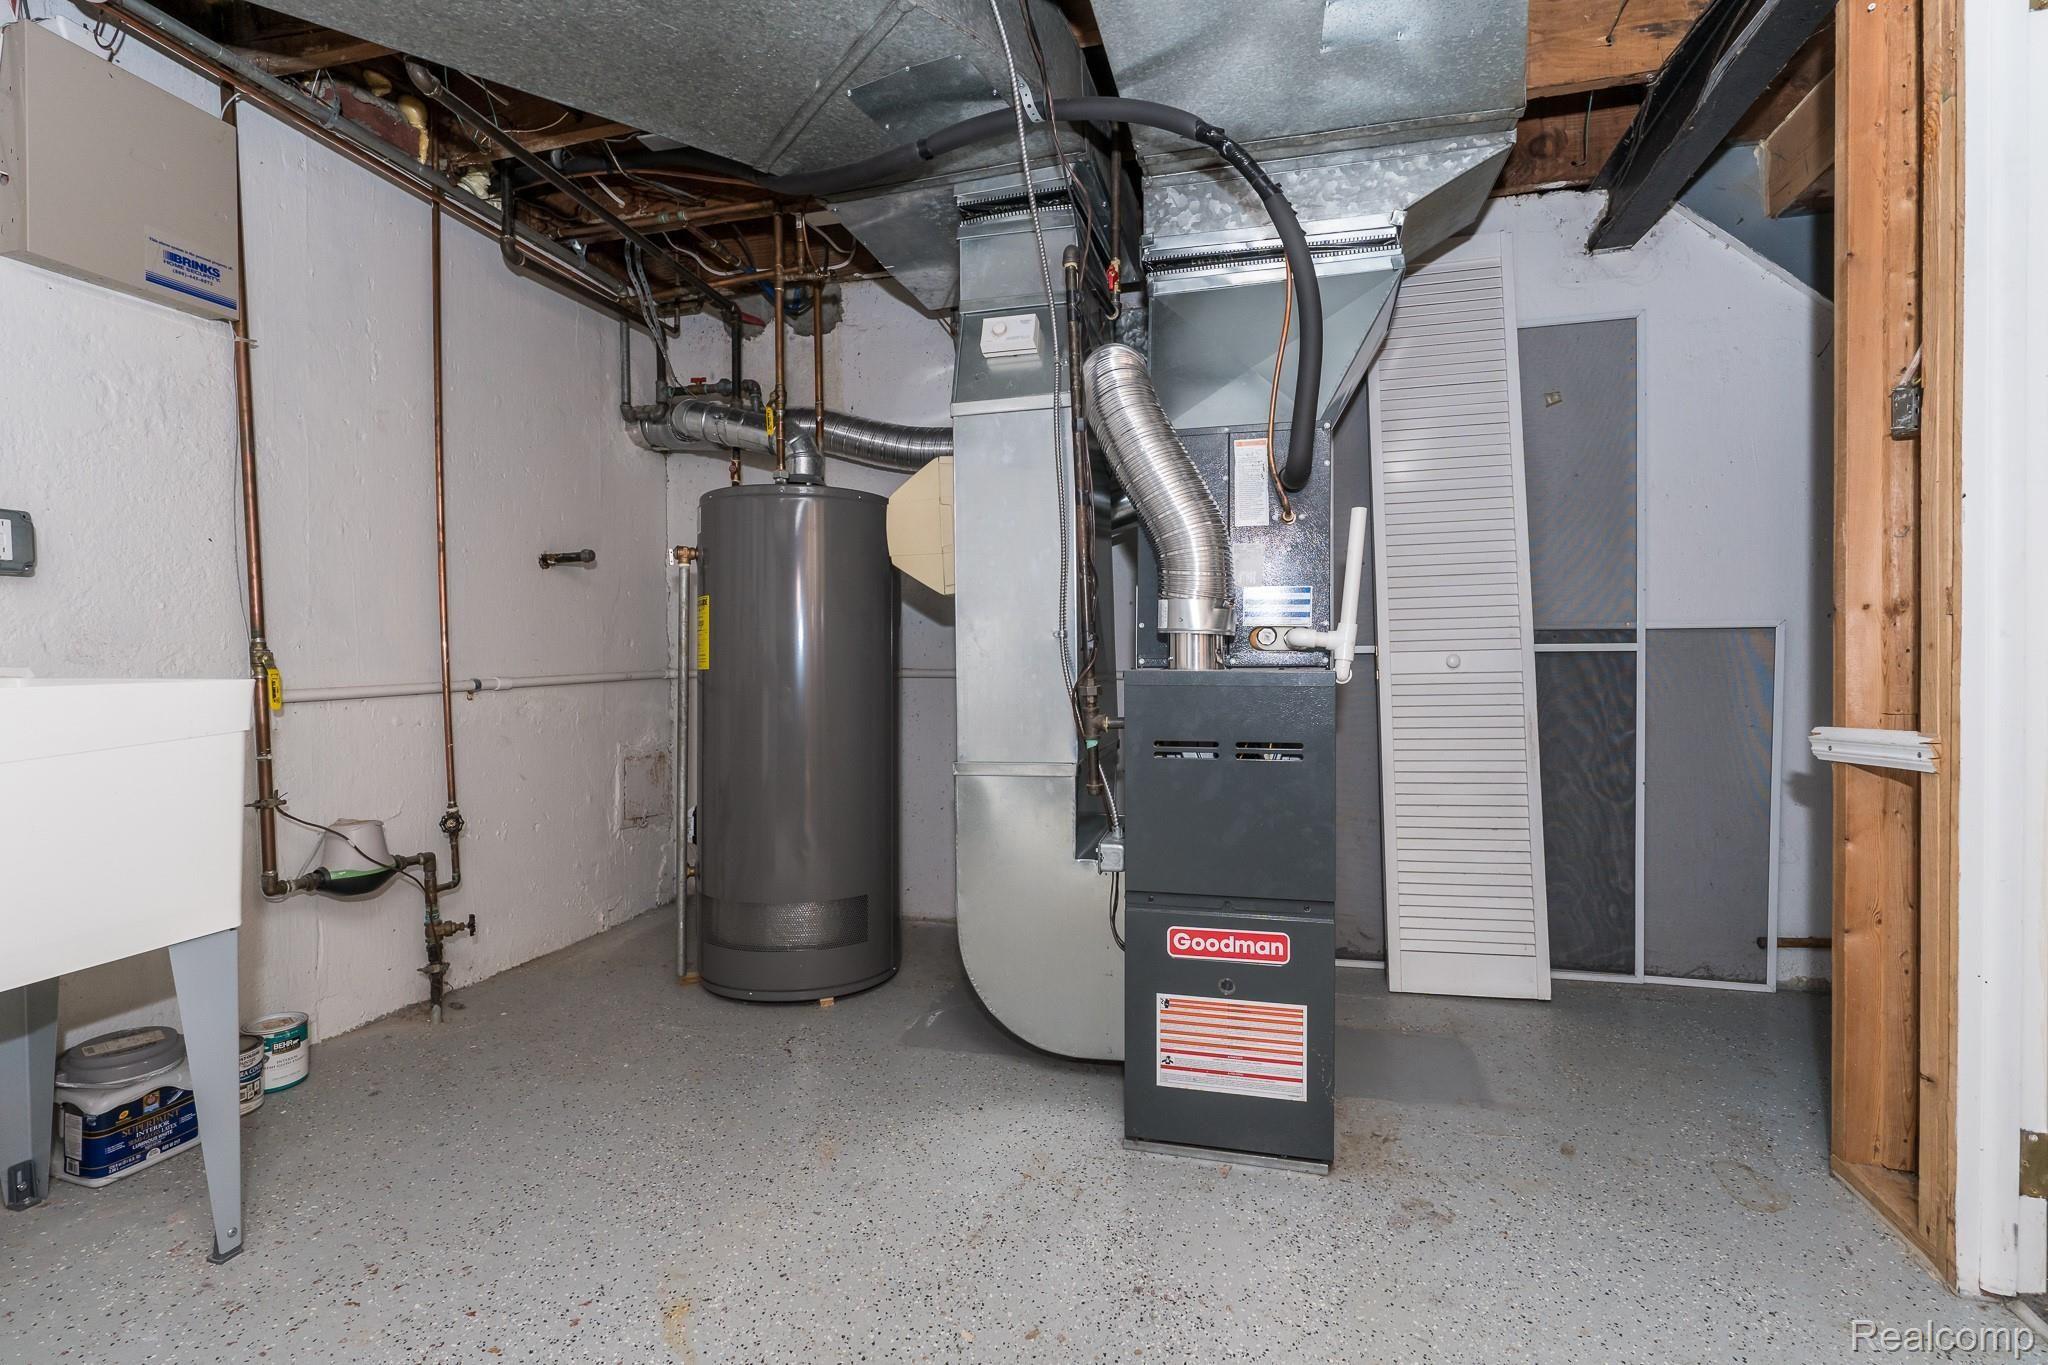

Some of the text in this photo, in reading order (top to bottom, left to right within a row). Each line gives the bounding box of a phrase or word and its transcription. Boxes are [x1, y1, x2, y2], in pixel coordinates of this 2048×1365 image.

[163, 259, 185, 271] HOME
[170, 253, 221, 278] BRINKS
[1173, 932, 1284, 956] Goodman
[273, 1040, 293, 1051] BEHR
[136, 1120, 170, 1138] INTERIOR
[161, 1121, 178, 1134] LATEX
